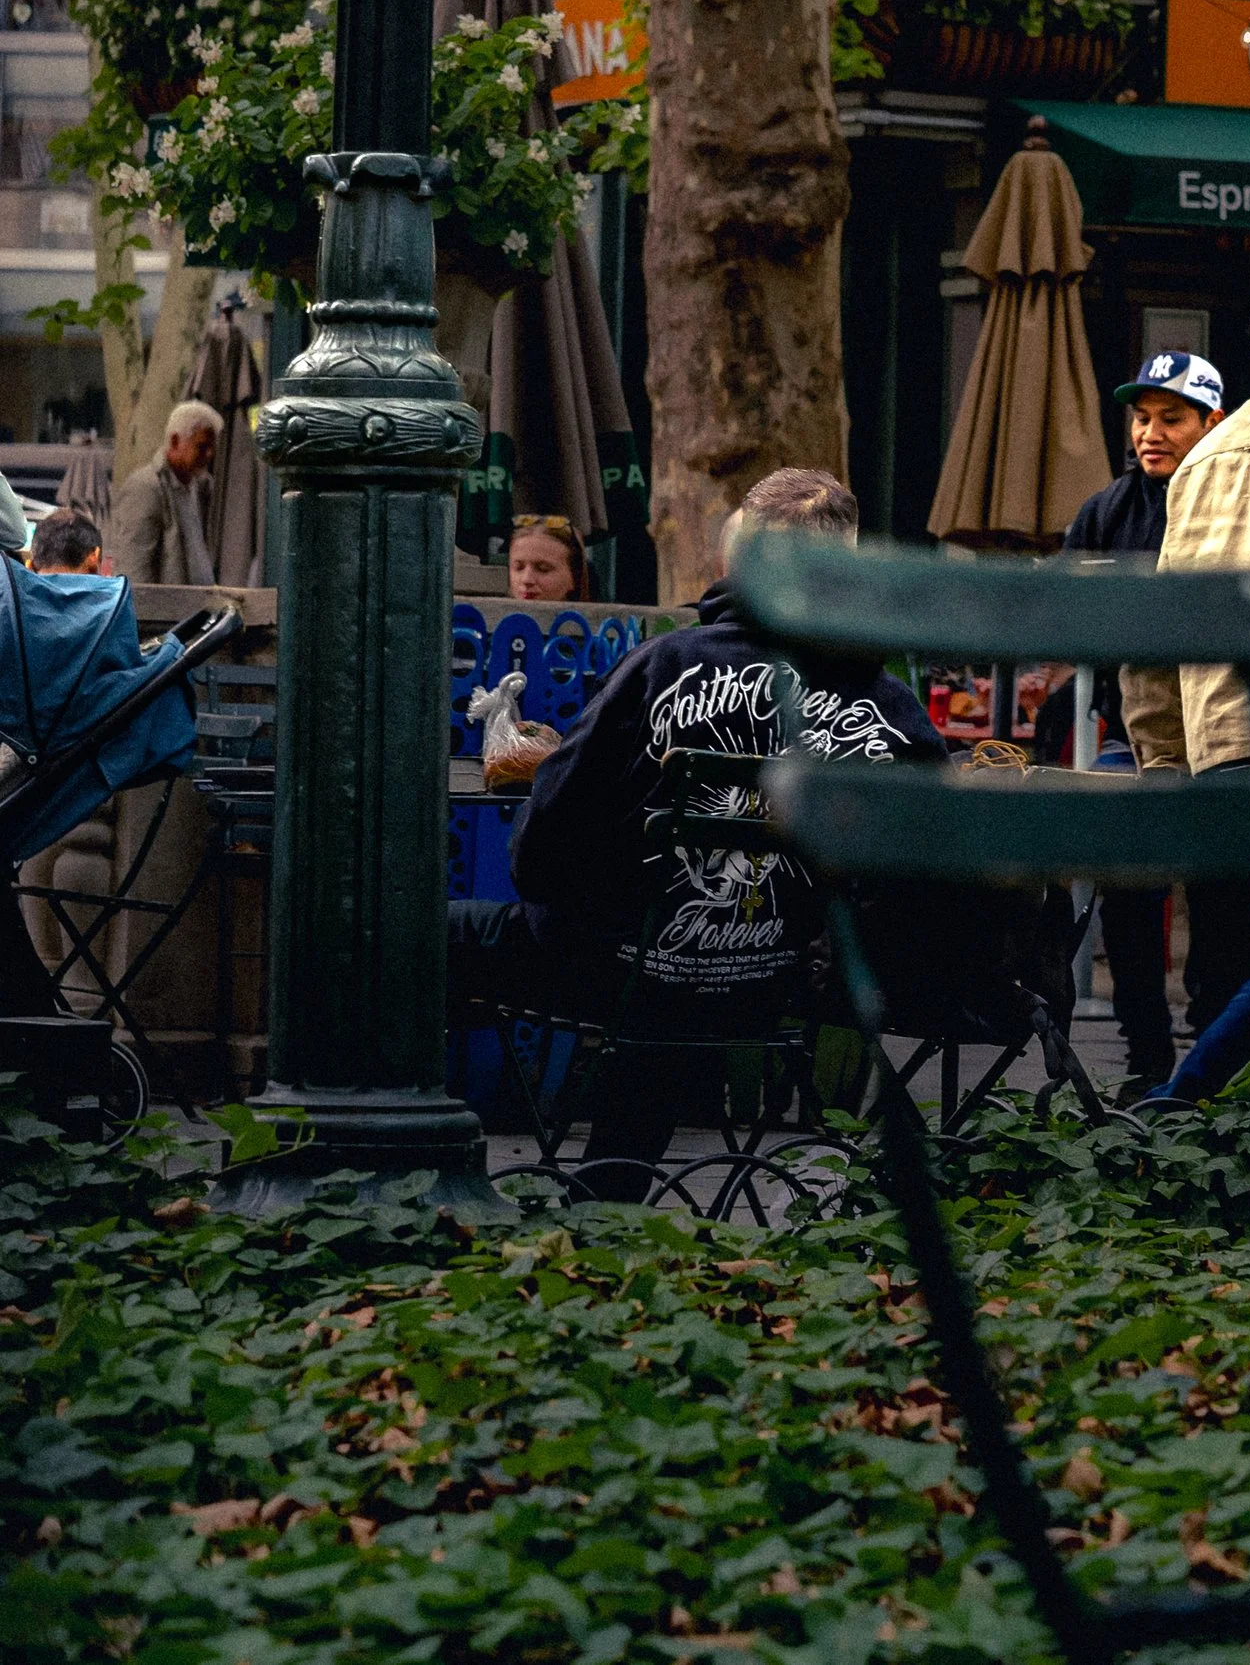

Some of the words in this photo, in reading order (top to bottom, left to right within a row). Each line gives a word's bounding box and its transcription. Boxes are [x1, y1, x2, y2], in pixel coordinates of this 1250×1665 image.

[646, 663, 743, 760] Faith
[737, 661, 841, 721] Over
[656, 898, 784, 954] Forever
[620, 944, 638, 954] FOR
[657, 951, 669, 961] SO
[669, 954, 696, 965] LOVED
